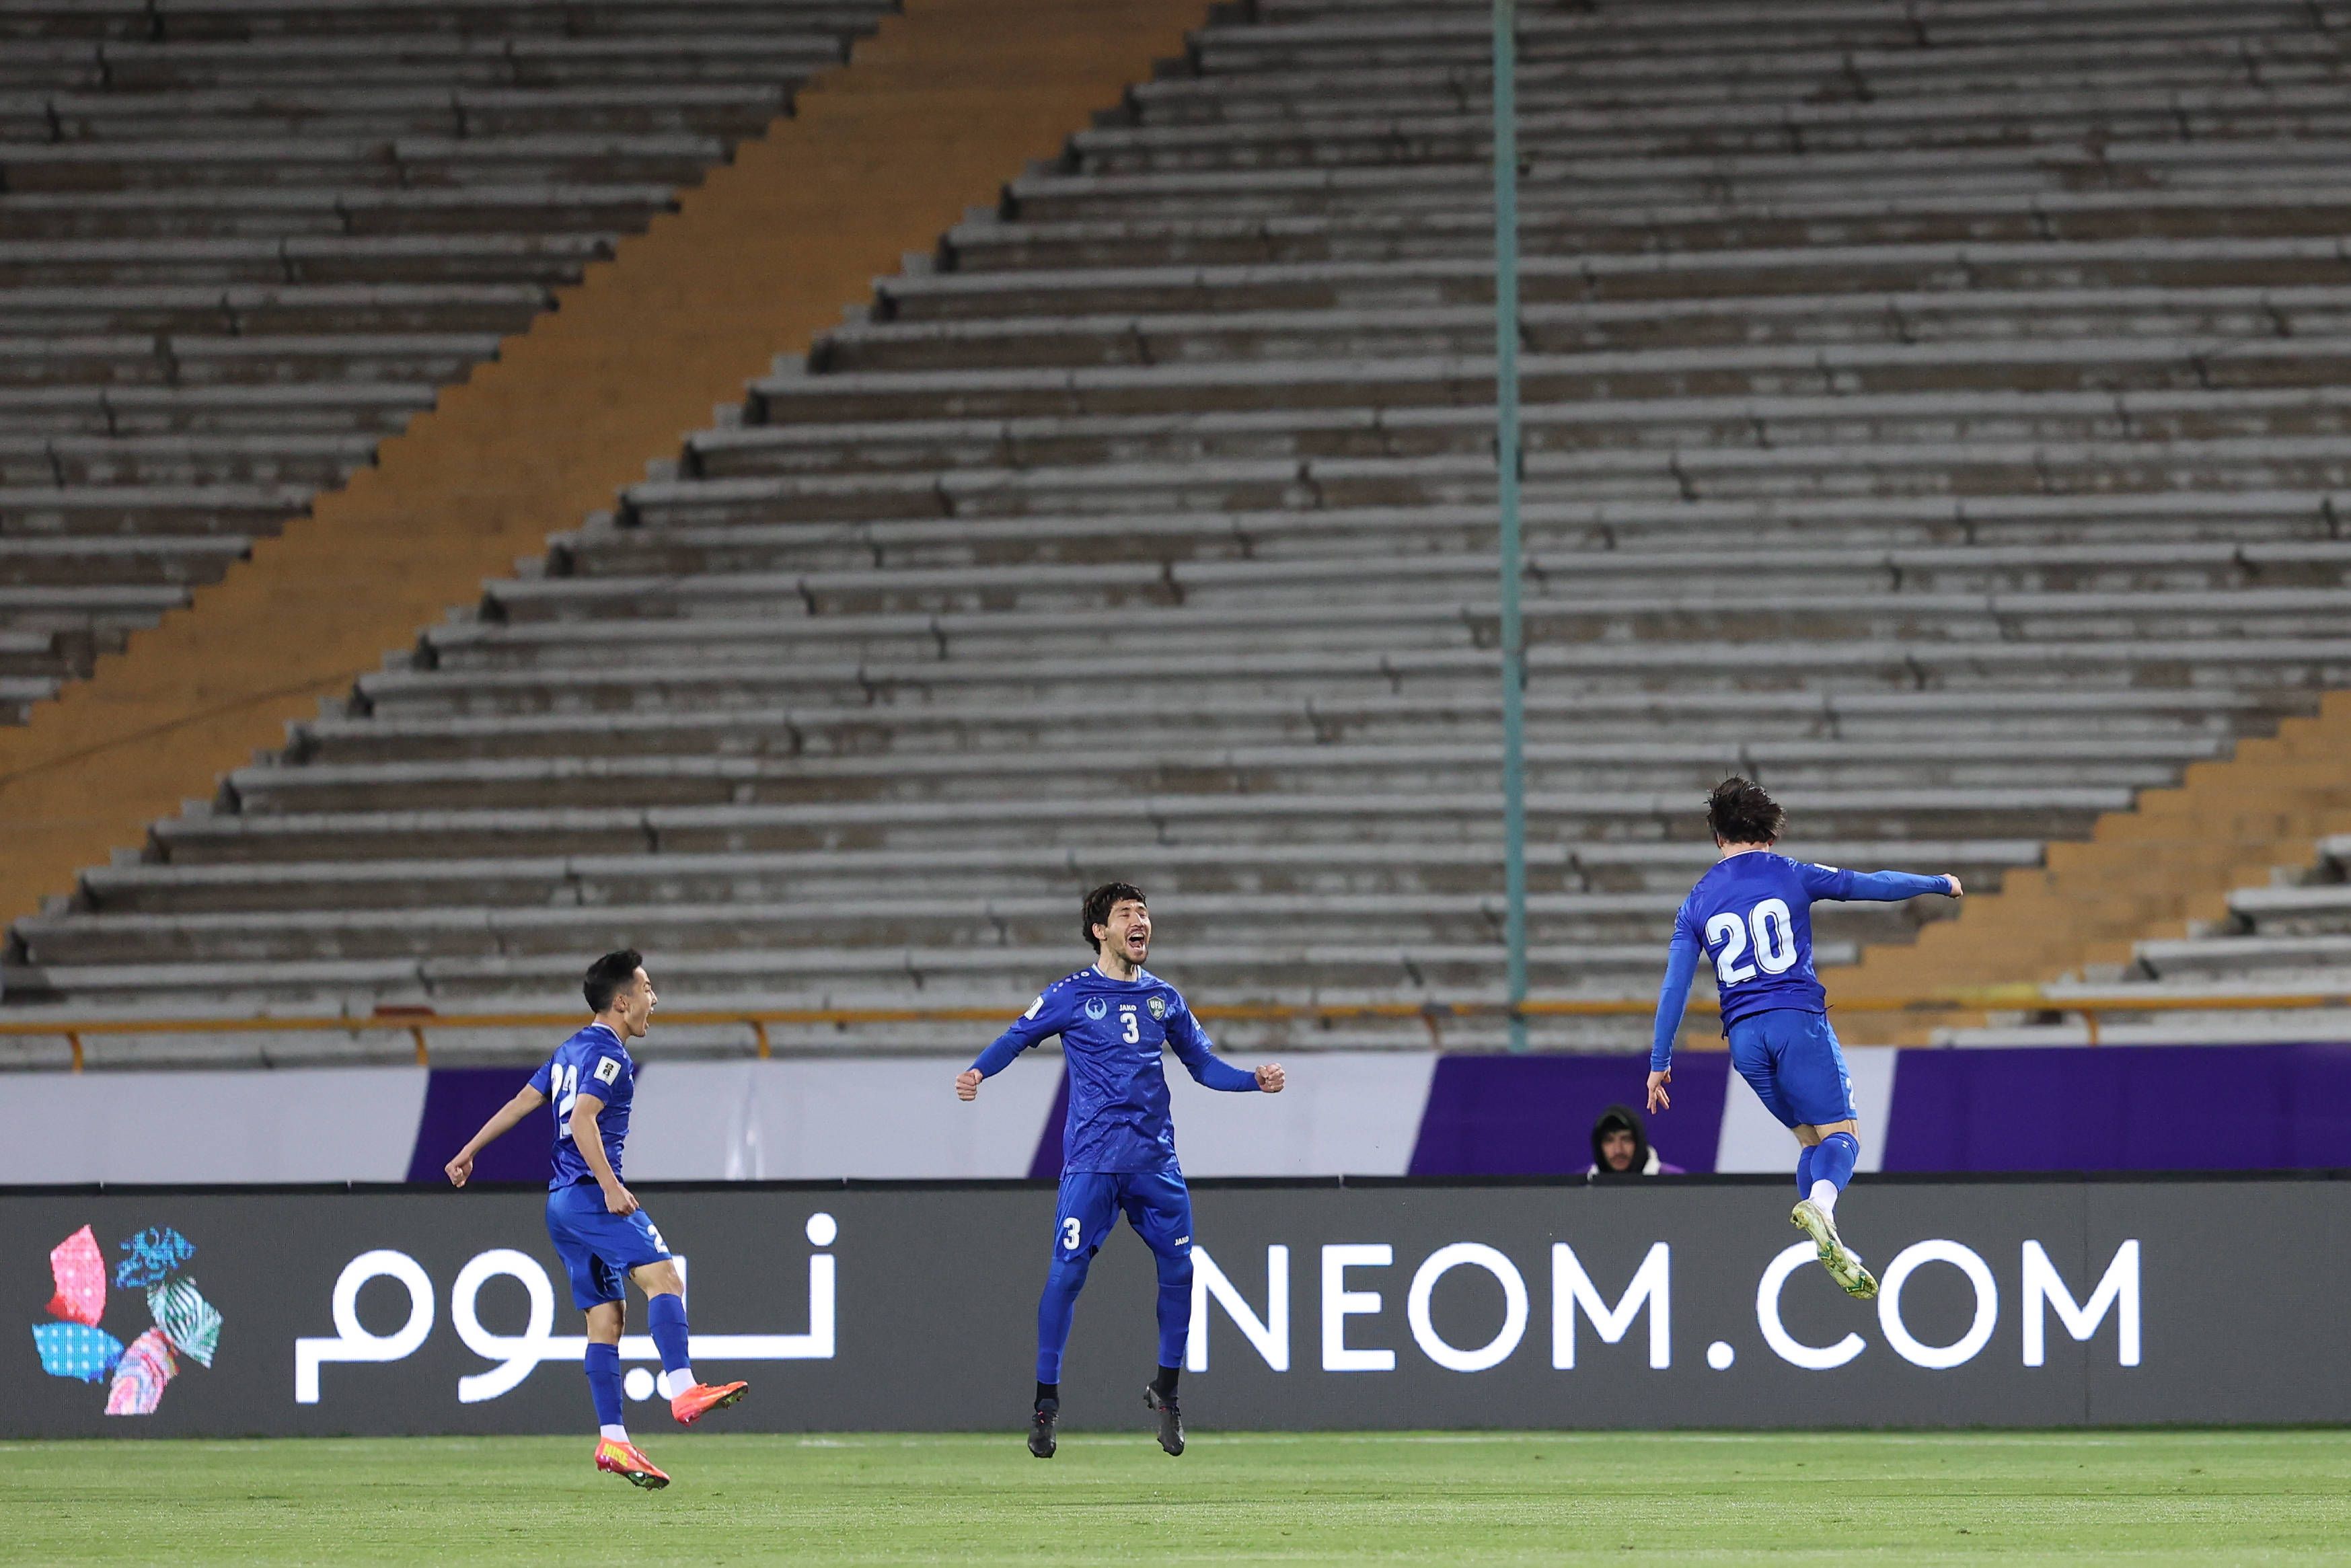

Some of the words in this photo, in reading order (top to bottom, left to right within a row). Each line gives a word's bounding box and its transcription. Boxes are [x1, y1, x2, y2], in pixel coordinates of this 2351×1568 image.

[1705, 898, 1797, 987] 20
[1150, 1001, 1163, 1010] UFA
[1120, 1012, 1140, 1043] 3
[1063, 1217, 1081, 1250] 3
[1174, 1236, 1189, 1246] JAKO
[295, 1214, 836, 1403] نيوم
[1185, 1239, 2140, 1372] NEOM.COM
[603, 1443, 628, 1467] NIKE
